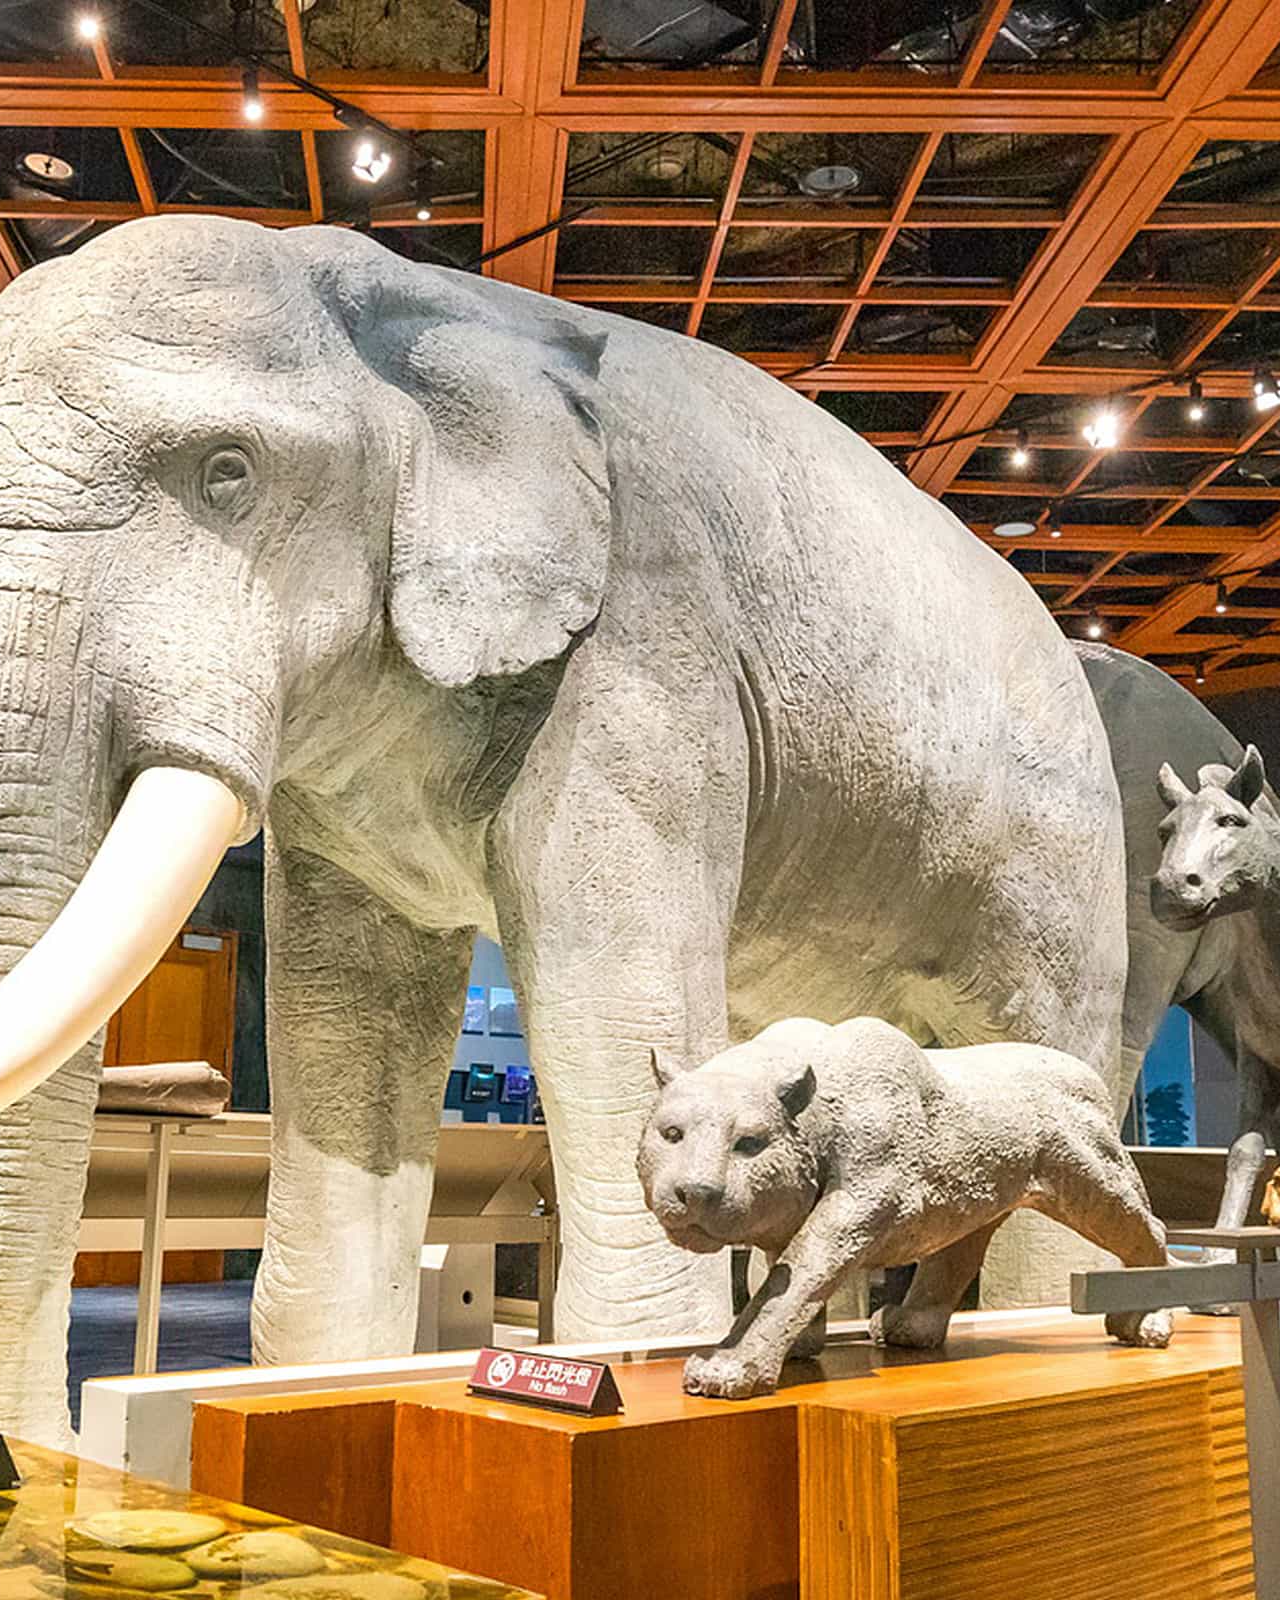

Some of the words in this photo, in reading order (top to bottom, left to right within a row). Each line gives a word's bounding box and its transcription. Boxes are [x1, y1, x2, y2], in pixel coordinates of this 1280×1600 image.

[518, 1359, 592, 1386] 禁止閃光燈
[528, 1380, 543, 1392] No
